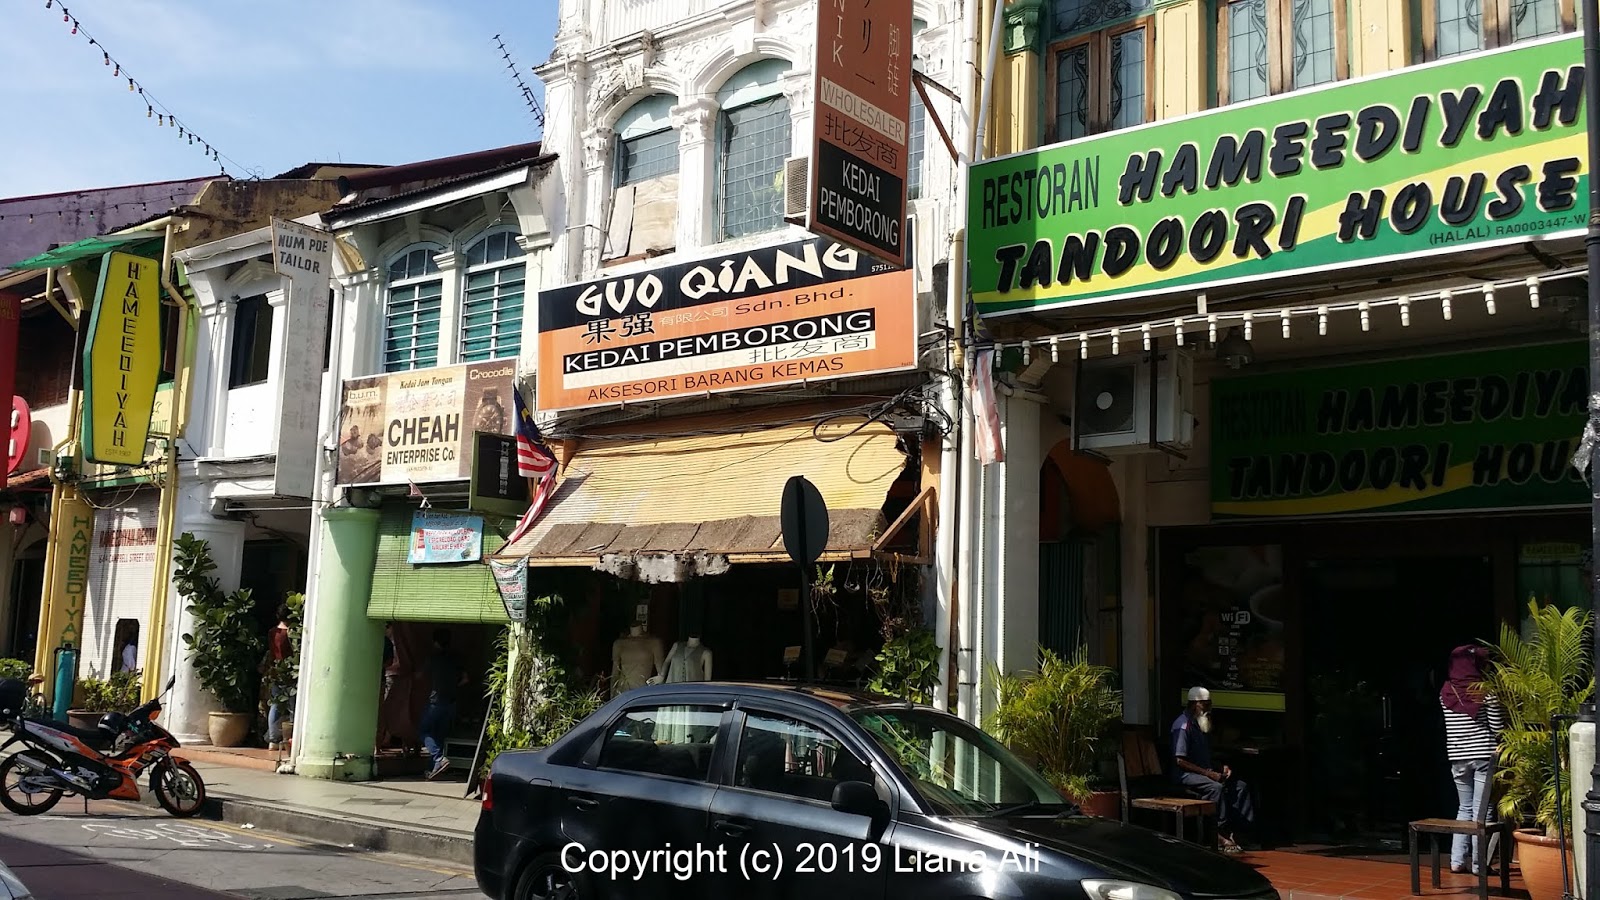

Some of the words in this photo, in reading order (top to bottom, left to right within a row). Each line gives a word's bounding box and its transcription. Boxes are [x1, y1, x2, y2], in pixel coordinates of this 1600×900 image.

[822, 81, 903, 143] WHOLESALER
[825, 112, 899, 170] 批发商
[1117, 64, 1587, 207] HAMEEDIYAH
[842, 159, 881, 203] KEDAI
[983, 154, 1100, 230] RESTORAN
[820, 187, 899, 247] PEMBORONG
[995, 195, 1308, 294] TANDOORI
[1338, 156, 1582, 245] HOUSE
[1429, 226, 1490, 245] (HALAL)
[1495, 214, 1587, 236] RA0003447-W
[278, 234, 304, 250] NUM
[309, 238, 328, 253] POE
[280, 251, 320, 274] TAILOR
[575, 277, 663, 316] GUO
[564, 344, 651, 373] KEDAI
[659, 310, 872, 360] PEMBORONG
[581, 312, 656, 345] 果强
[659, 306, 729, 327] 有限公司
[112, 261, 142, 448] HAMEEDIYAH
[748, 333, 871, 364] 批发商
[400, 379, 416, 390] Kedai
[417, 378, 429, 388] Jam
[469, 366, 514, 380] Crocodile
[587, 377, 677, 401] AKSESORI
[685, 366, 764, 389] BARANG
[772, 356, 844, 378] KEMAS
[349, 390, 378, 400] b.u.m.
[387, 413, 459, 448] CHEAH
[386, 448, 440, 465] ENTERPRISE
[442, 446, 455, 462] Co.
[1227, 441, 1452, 498] TANDOORI
